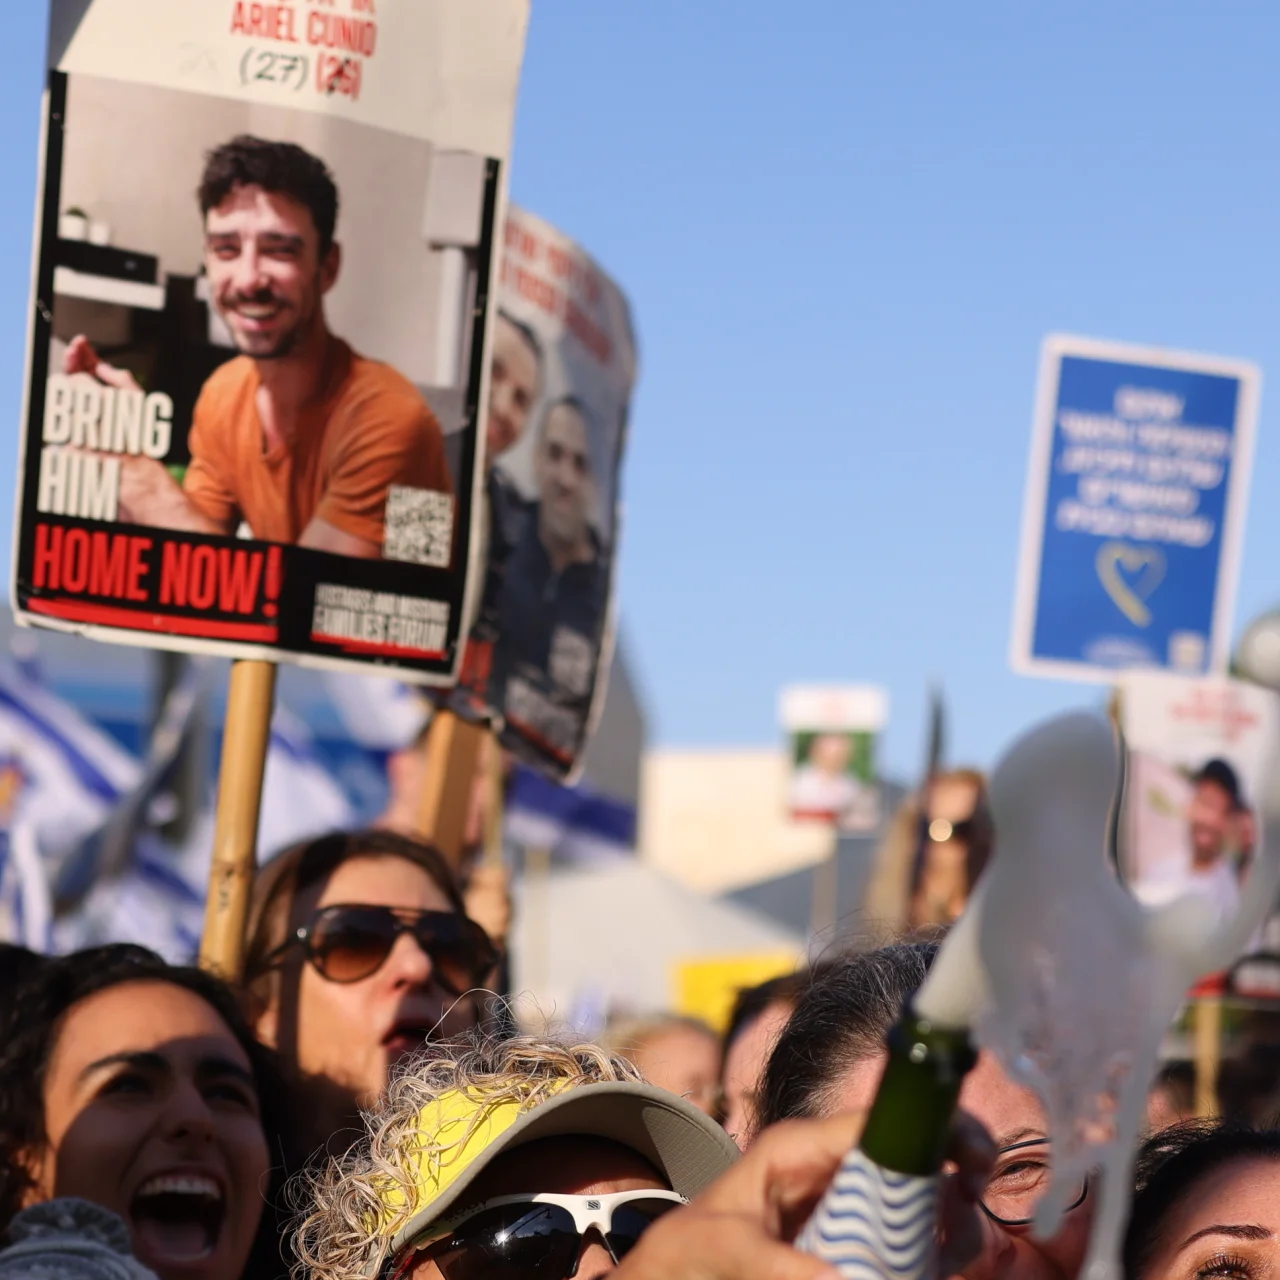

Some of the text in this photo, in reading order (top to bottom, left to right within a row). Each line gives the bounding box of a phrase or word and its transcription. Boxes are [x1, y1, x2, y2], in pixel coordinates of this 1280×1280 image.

[231, 1, 378, 58] ARIEL CUNIO
[239, 46, 309, 91] (27)
[42, 374, 174, 459] BRING
[37, 445, 120, 522] HIM
[32, 523, 283, 618] HOME NOW!
